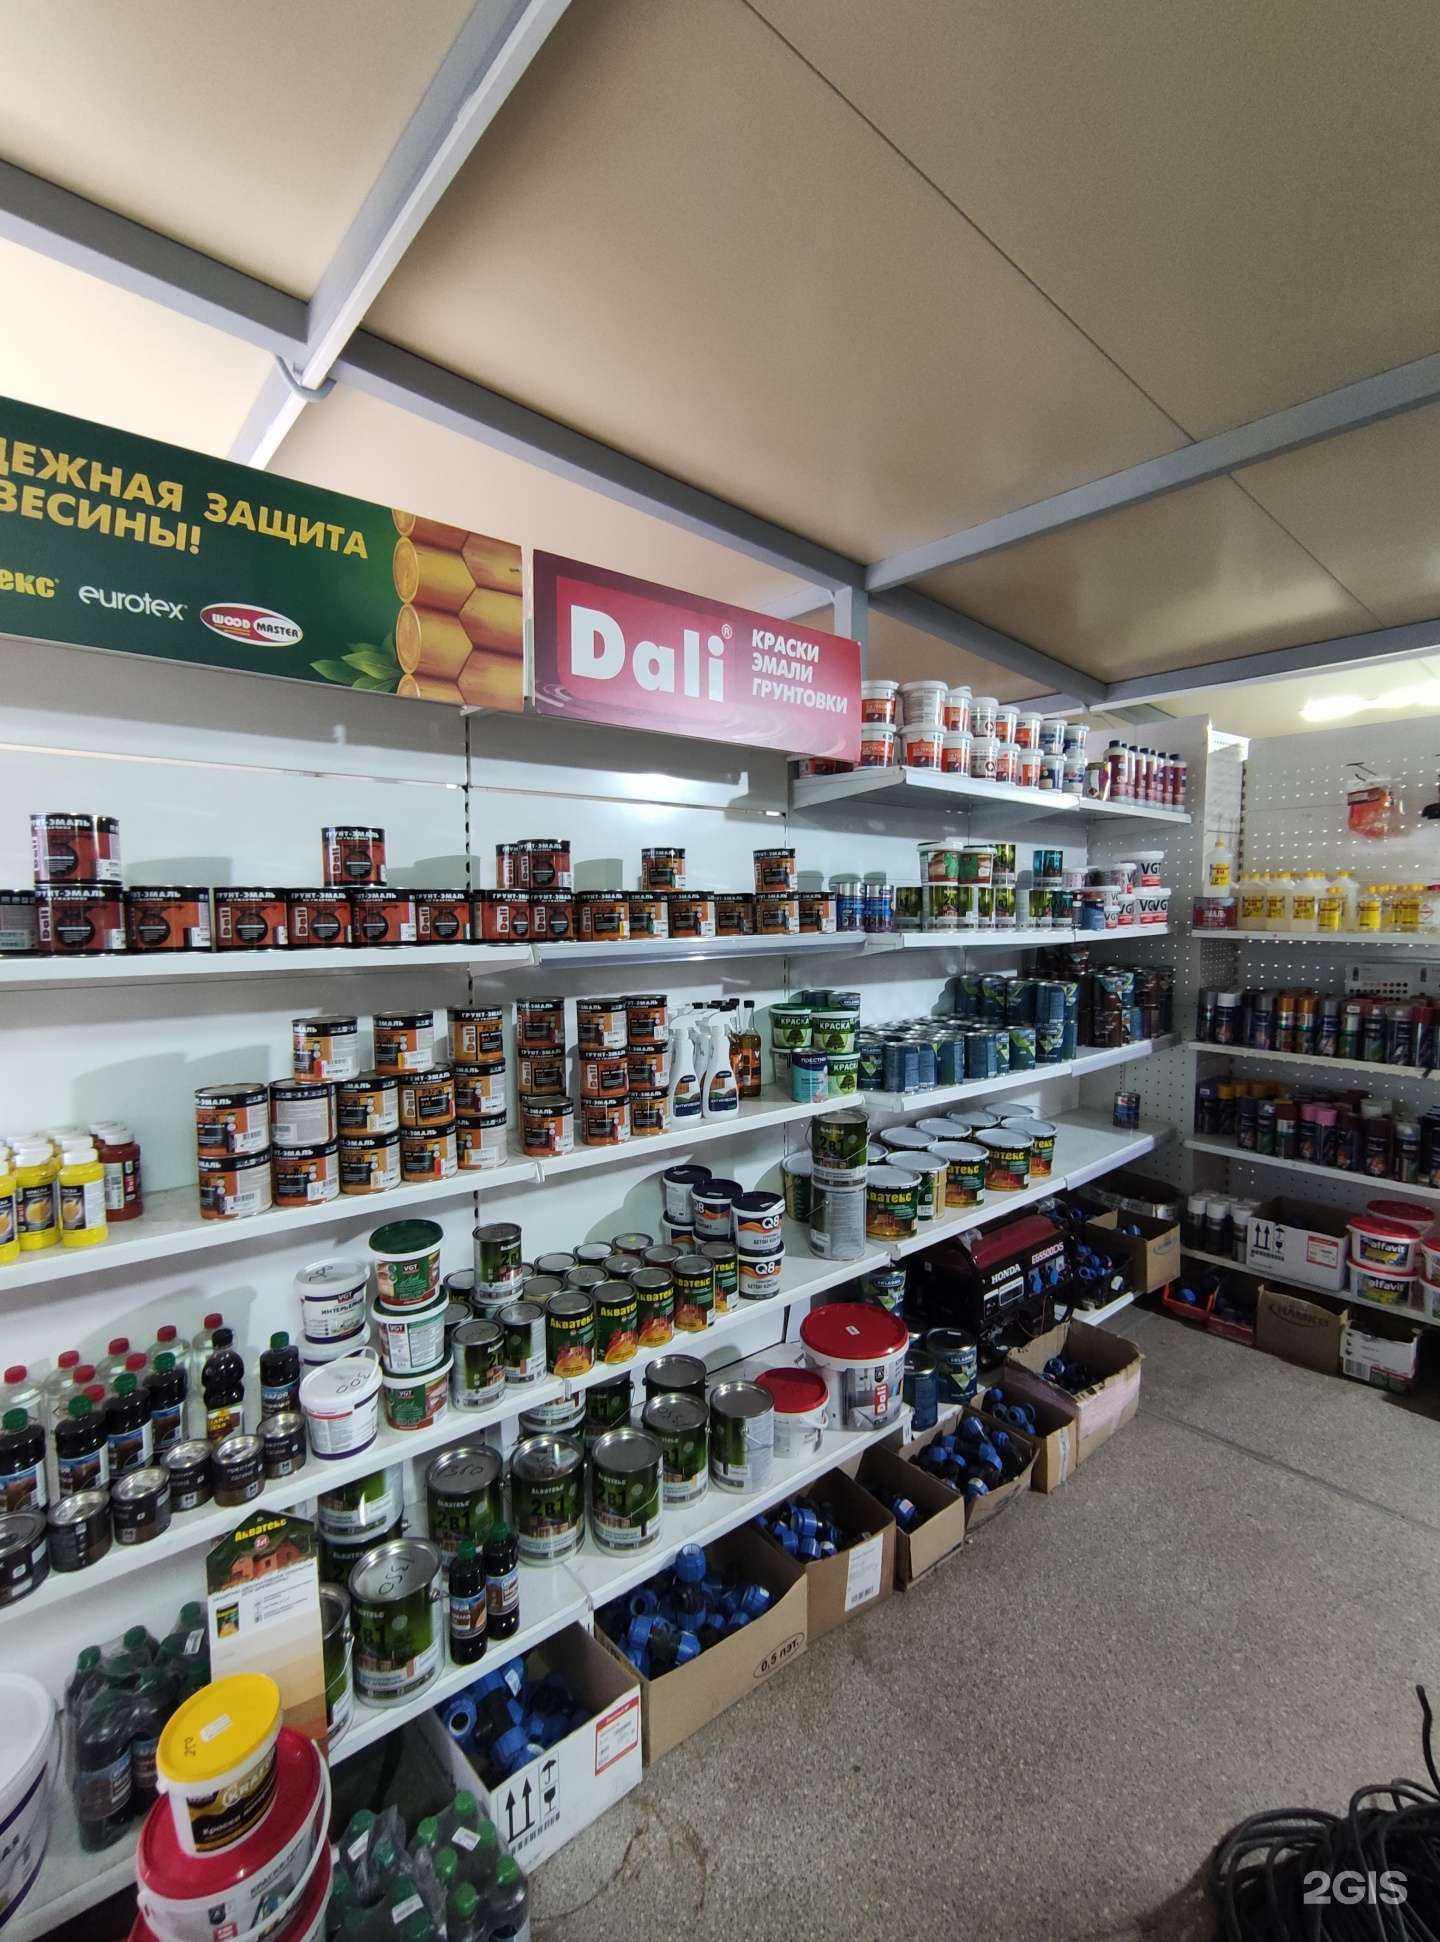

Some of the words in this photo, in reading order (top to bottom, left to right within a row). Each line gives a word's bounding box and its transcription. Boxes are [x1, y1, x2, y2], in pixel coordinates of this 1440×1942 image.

[203, 492, 368, 559] ЗАЩИТА
[78, 585, 184, 621] eurotex
[211, 613, 251, 630] WOOD
[256, 621, 299, 639] MASTER
[571, 604, 725, 702] Dali
[751, 629, 819, 663] КРАСКИ
[752, 652, 813, 683] ЭМАЛИ
[752, 679, 848, 714] ГРУНТОВКИ
[820, 1021, 851, 1031] КРАСКА
[762, 1217, 781, 1230] Q8
[1370, 1239, 1405, 1254] alfavit
[403, 1264, 418, 1272] VGT
[755, 1262, 775, 1275] Q8
[991, 1263, 1021, 1285] HONDA
[390, 1325, 404, 1333] VGT
[877, 1383, 888, 1415] Dali
